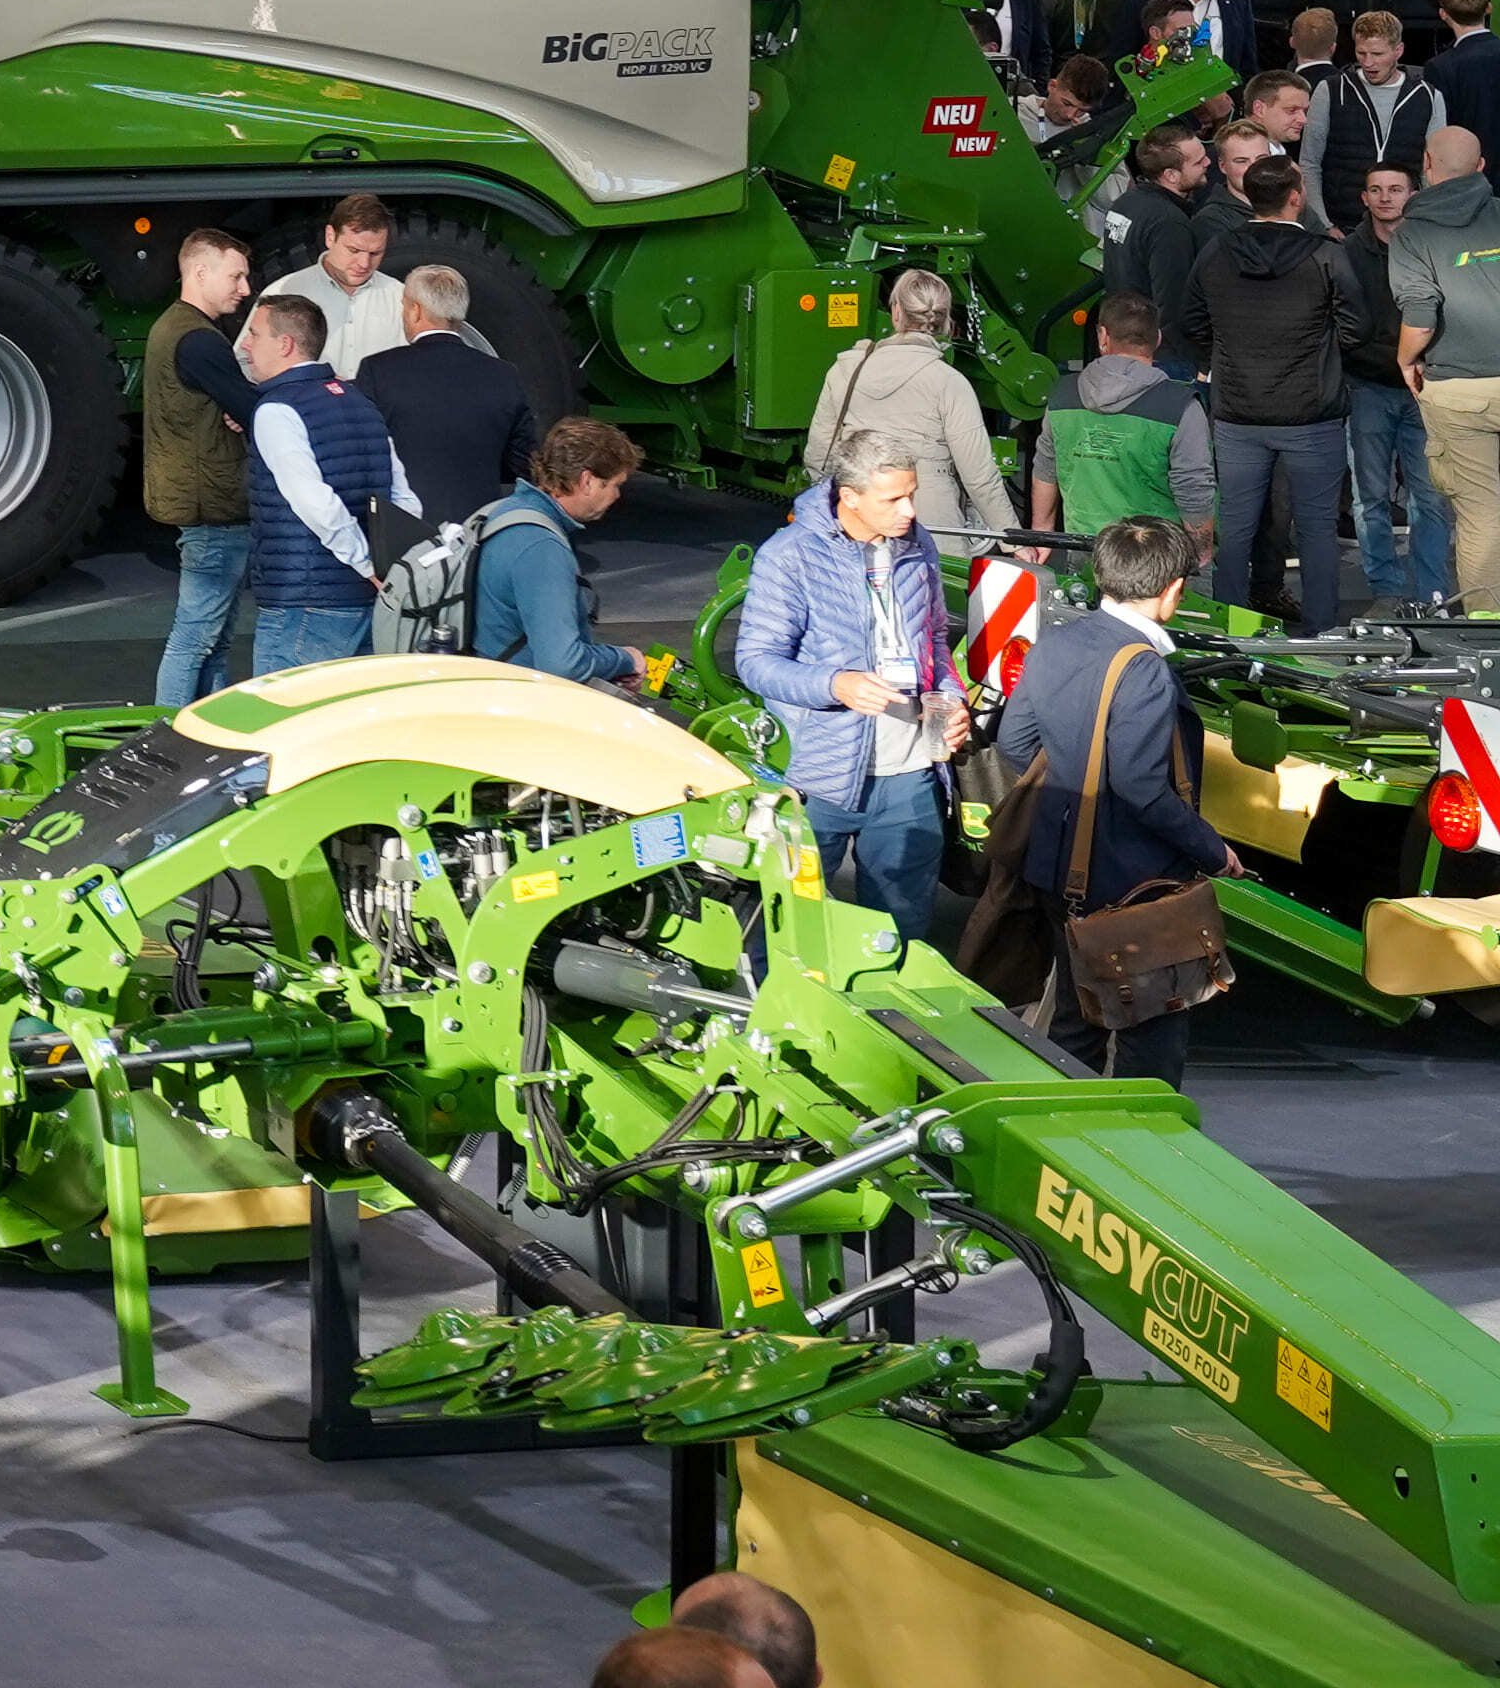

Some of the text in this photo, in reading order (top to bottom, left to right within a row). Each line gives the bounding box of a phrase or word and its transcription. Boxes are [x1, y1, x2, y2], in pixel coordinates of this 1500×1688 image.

[542, 27, 716, 64] BiGPACK
[622, 64, 647, 76] HDP
[661, 63, 687, 74] 1290
[690, 61, 706, 73] VC
[933, 105, 977, 126] NEU
[955, 136, 992, 153] NEW
[1035, 1163, 1250, 1365] EASYCUT
[1150, 1318, 1232, 1393] B1250 FOLD
